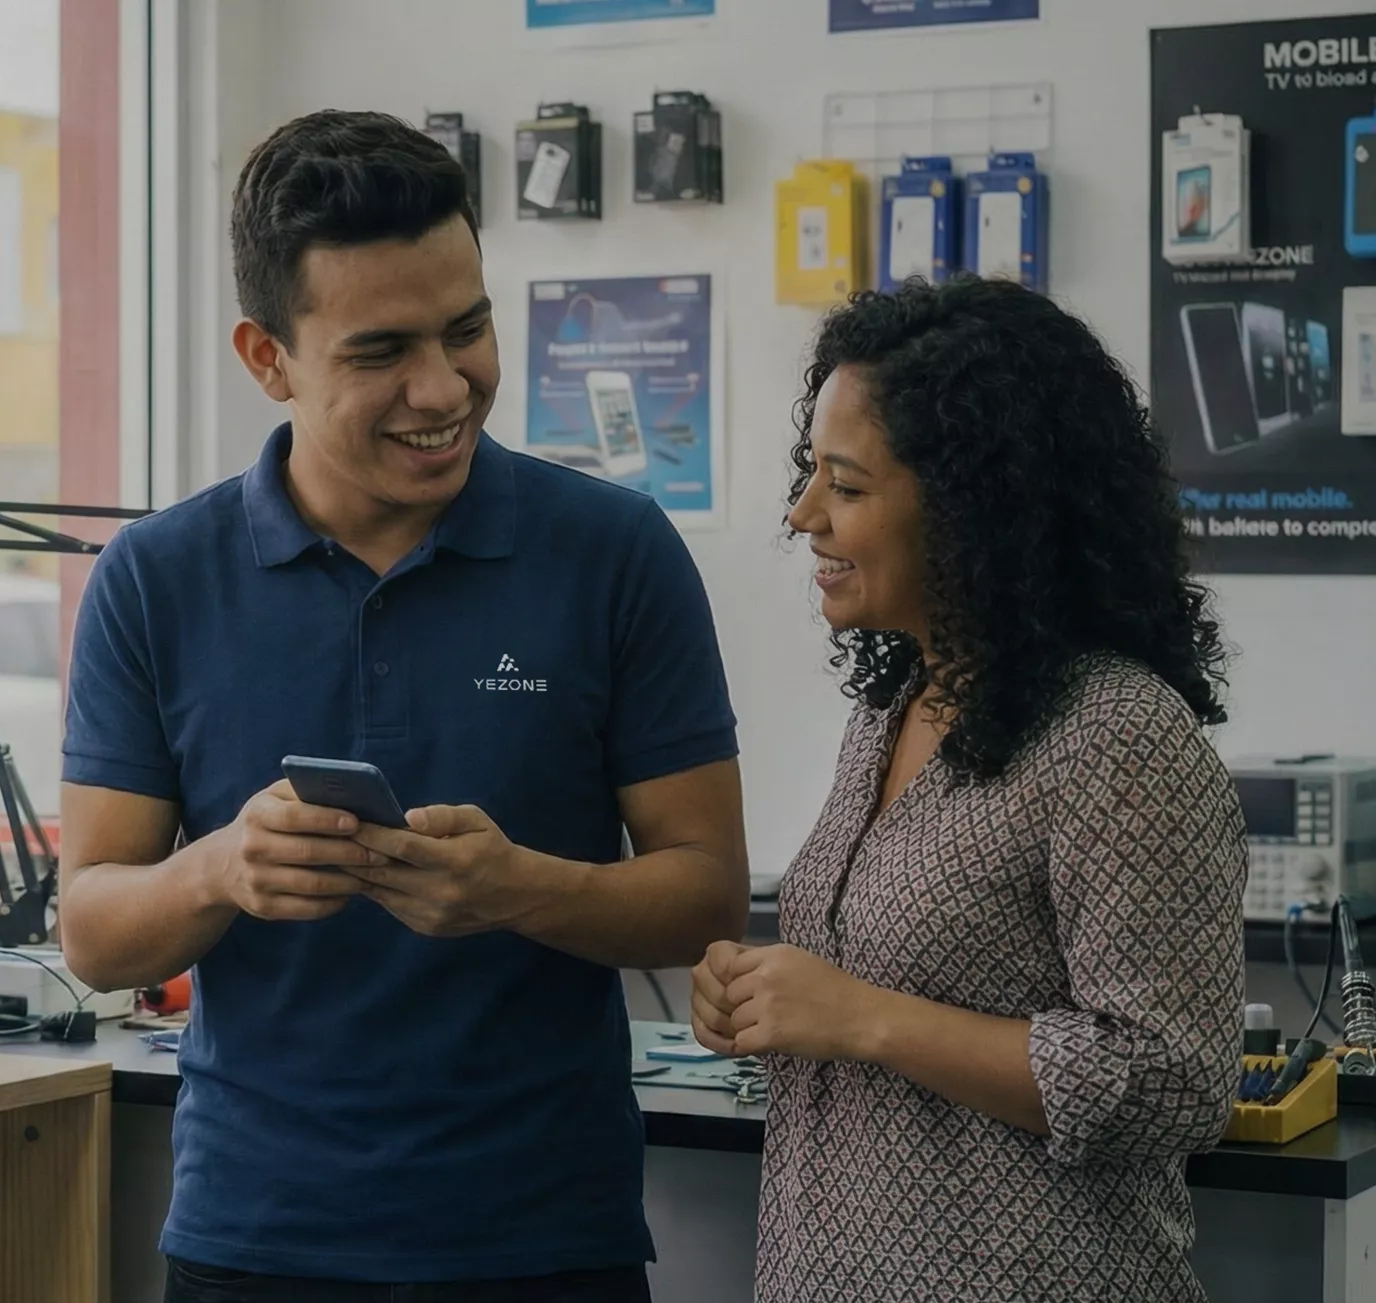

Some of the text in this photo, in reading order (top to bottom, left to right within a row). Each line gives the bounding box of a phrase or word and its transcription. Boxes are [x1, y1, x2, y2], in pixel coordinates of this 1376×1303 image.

[1264, 72, 1291, 91] TV
[1250, 244, 1314, 266] ZONE
[1282, 517, 1304, 537] to
[473, 678, 548, 692] YEZONE
